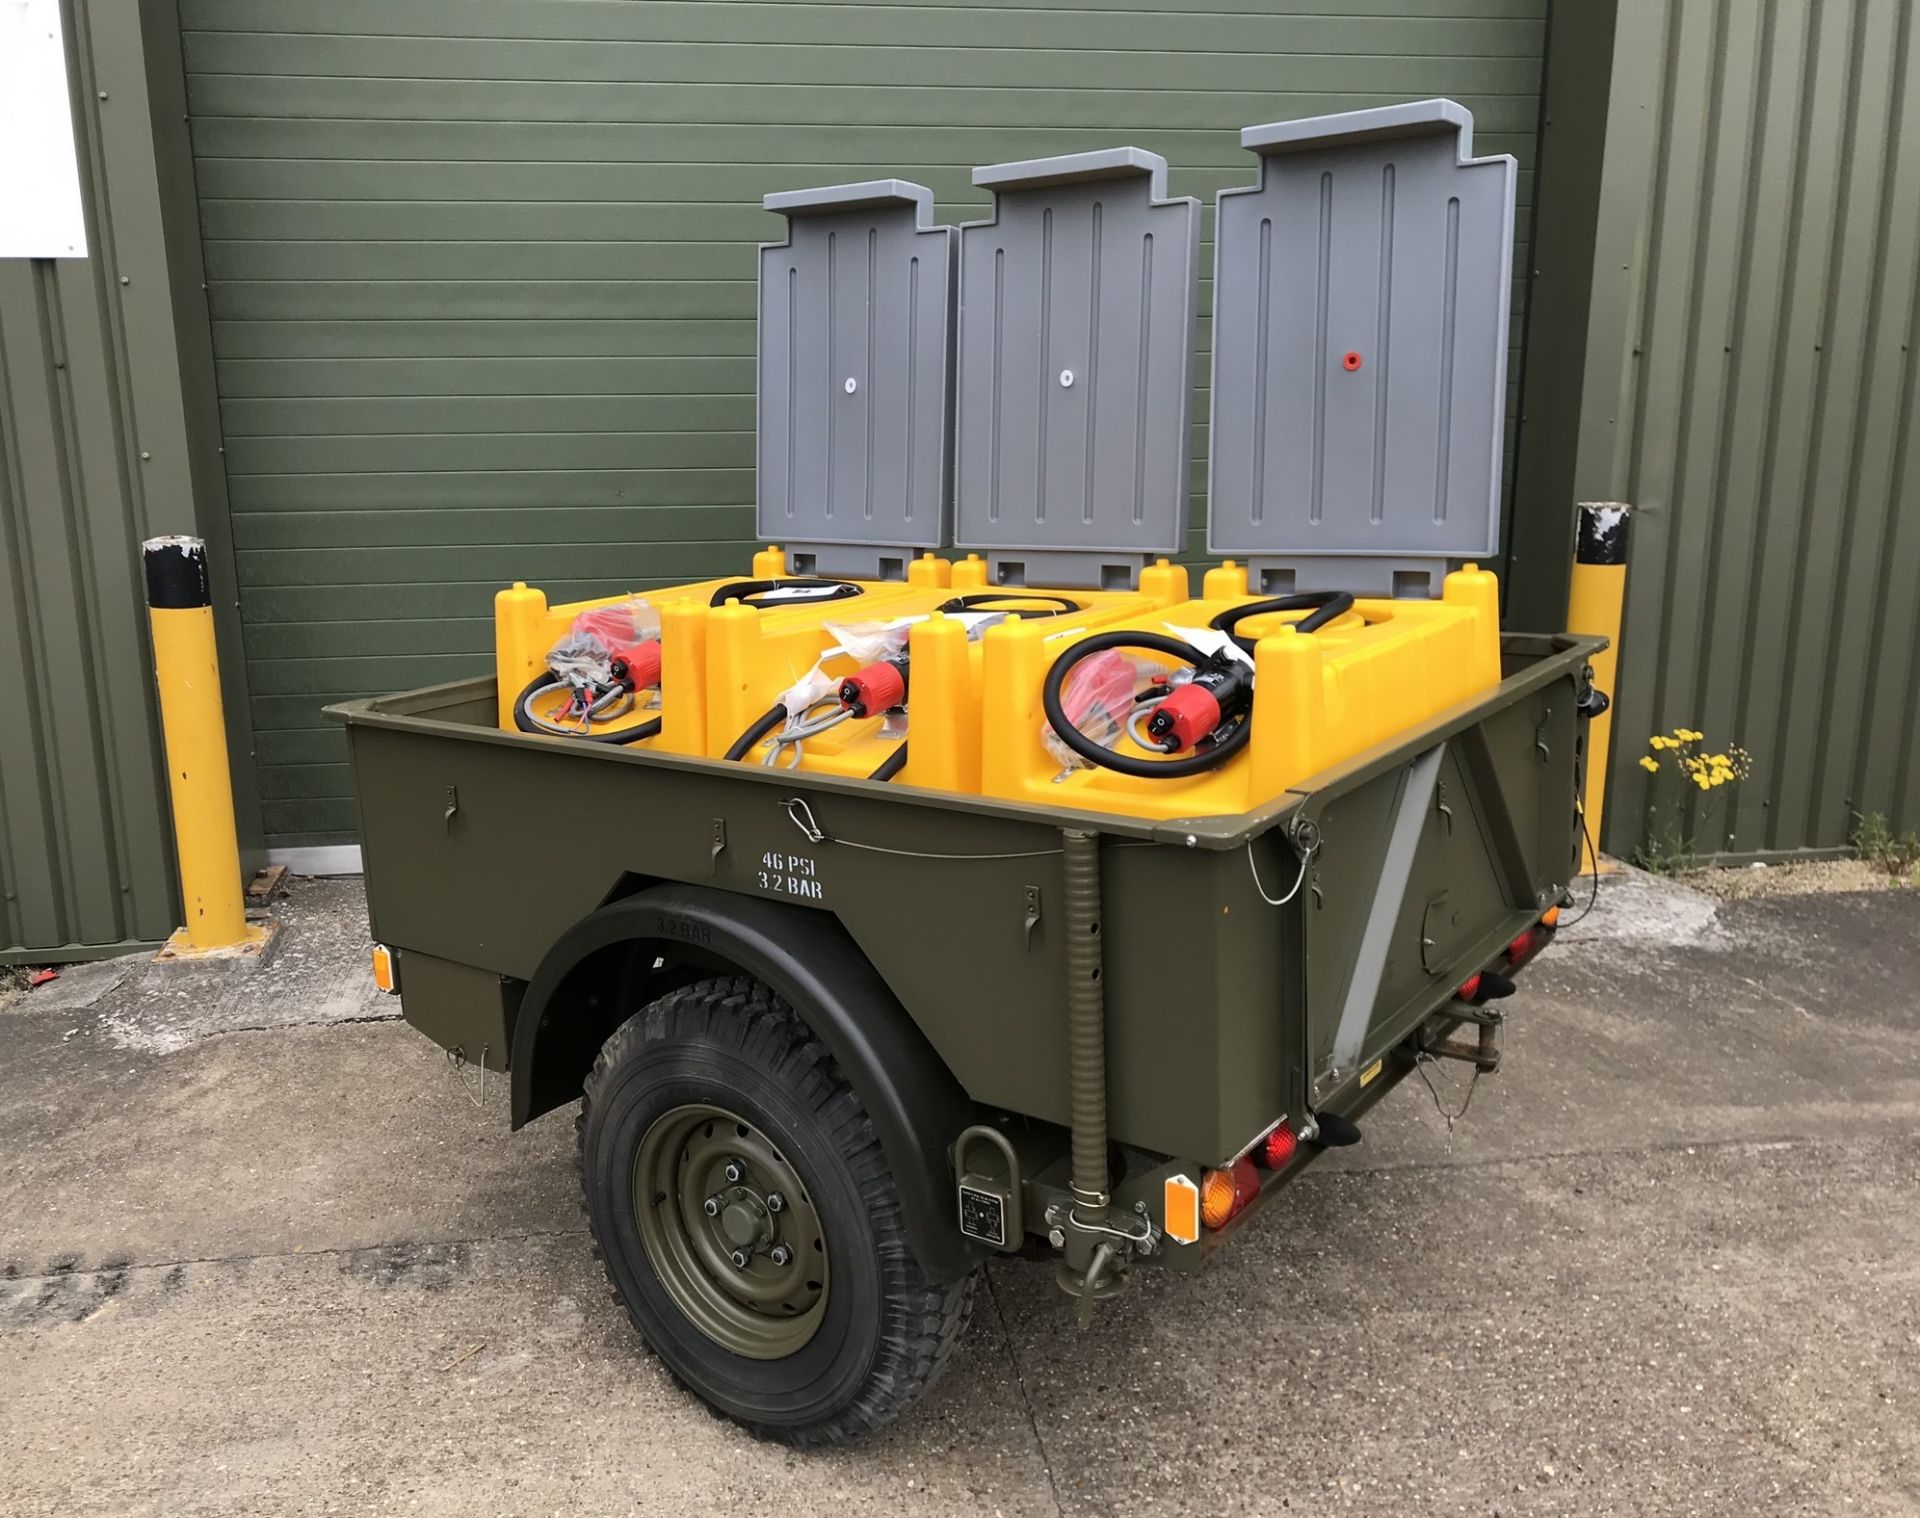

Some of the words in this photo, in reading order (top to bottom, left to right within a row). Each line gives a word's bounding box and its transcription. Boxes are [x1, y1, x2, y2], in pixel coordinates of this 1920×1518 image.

[762, 852, 783, 870] 46
[788, 855, 815, 877] PSI
[758, 871, 783, 892] 3.2
[787, 876, 822, 899] BAR
